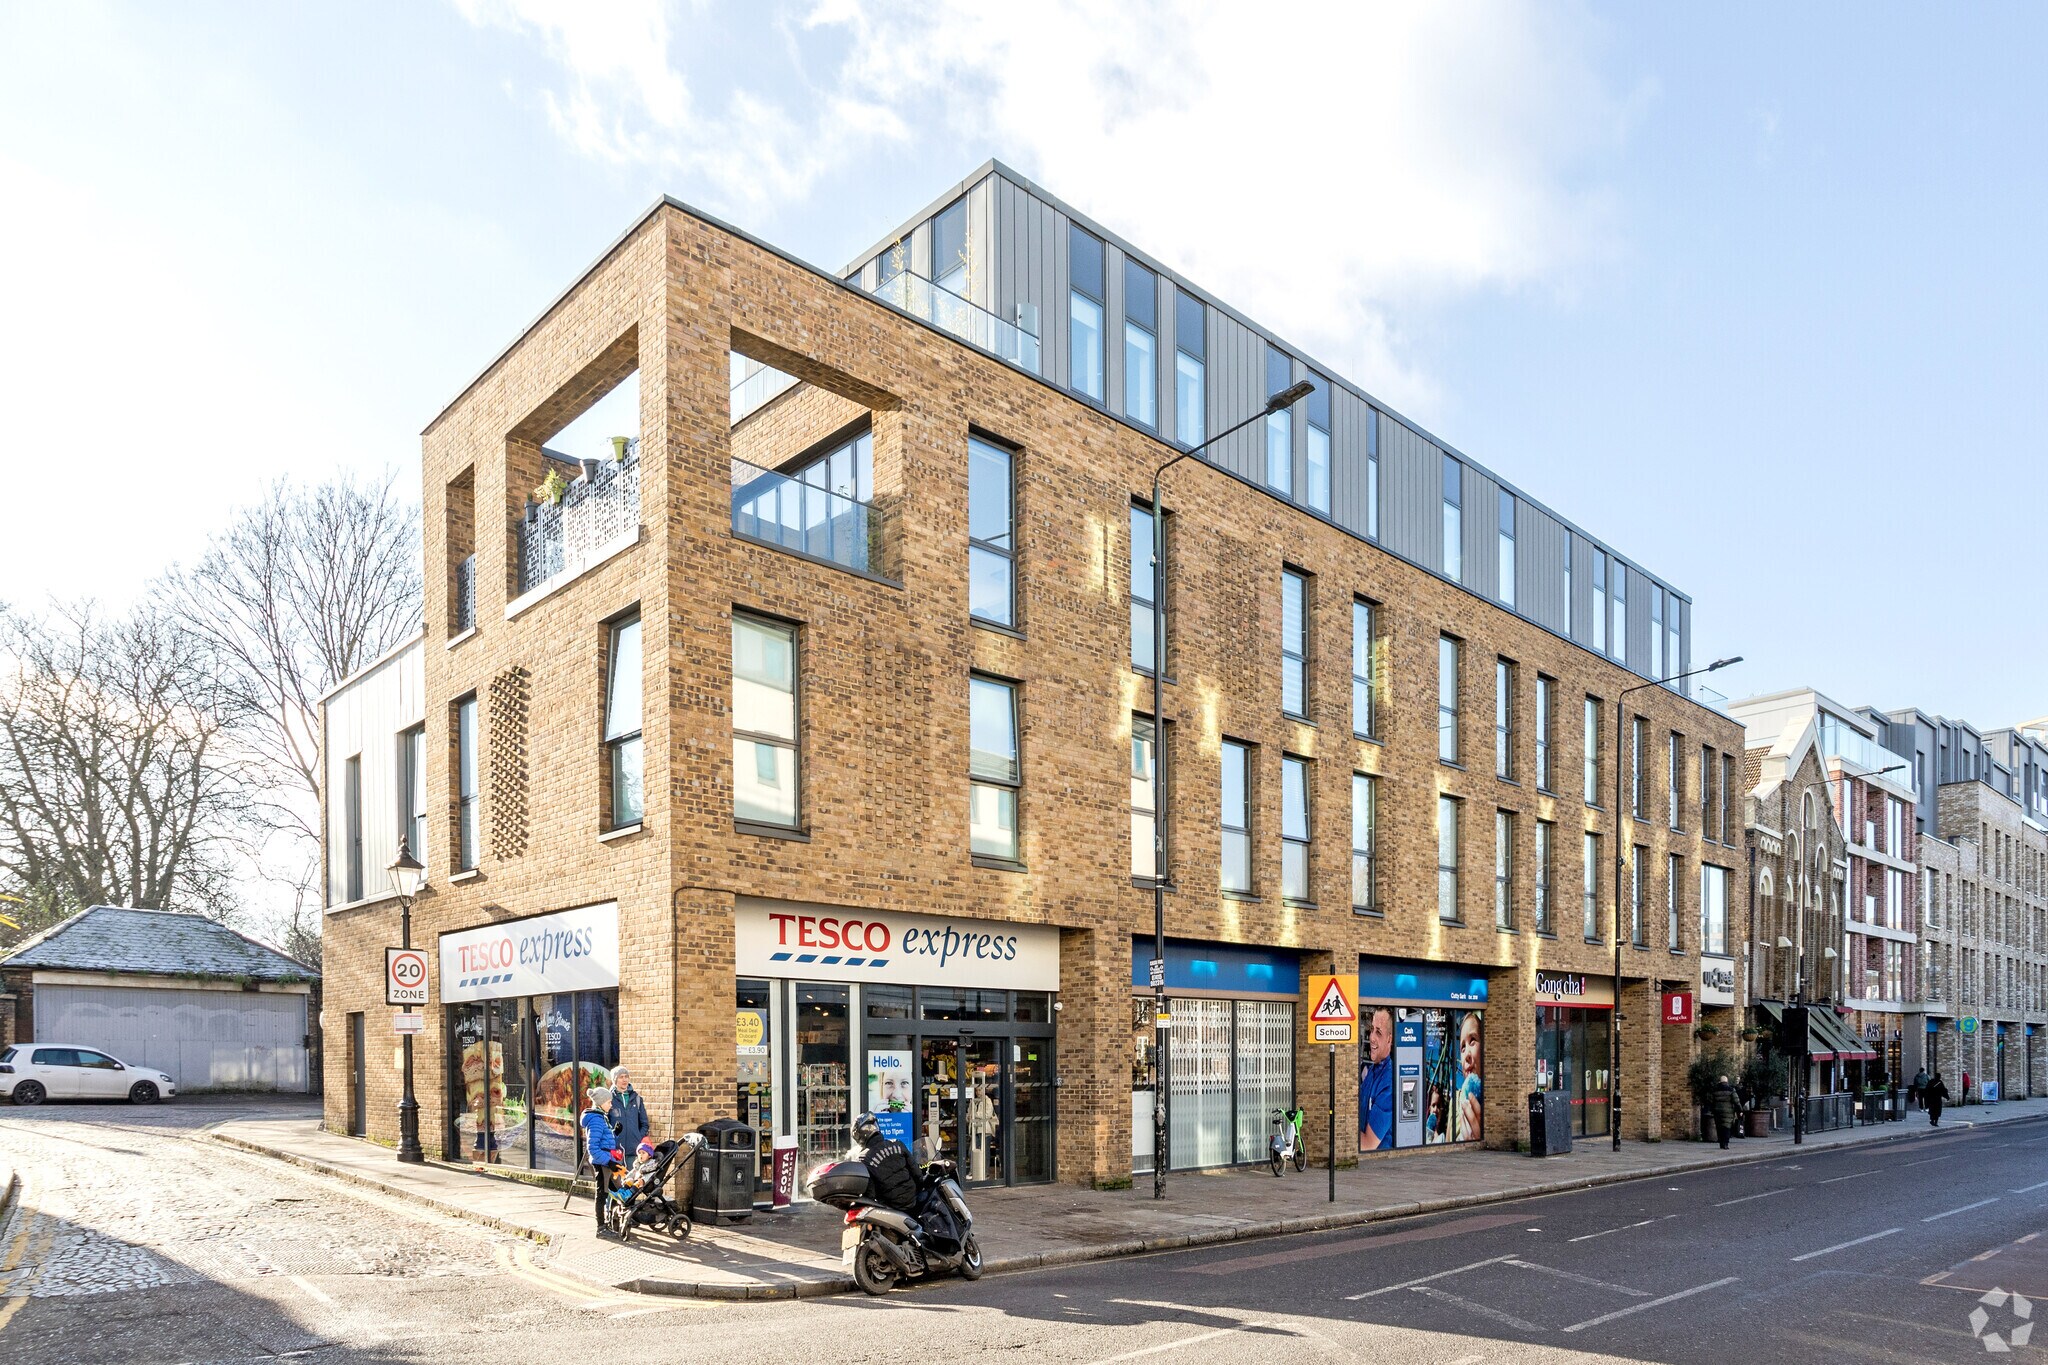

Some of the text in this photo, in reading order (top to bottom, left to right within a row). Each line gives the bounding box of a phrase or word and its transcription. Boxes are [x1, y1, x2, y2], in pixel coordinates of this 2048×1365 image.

[768, 912, 1017, 968] TESCO express
[458, 926, 593, 974] TESCO express
[397, 964, 420, 977] 20
[1536, 972, 1562, 1001] Gong
[1563, 974, 1580, 995] cha
[393, 990, 425, 999] ZONE
[736, 1017, 760, 1027] £3.40
[545, 1032, 561, 1040] TESCO
[1319, 1028, 1347, 1036] School
[873, 1055, 902, 1068] Hello.
[779, 1151, 790, 1194] COSTA
